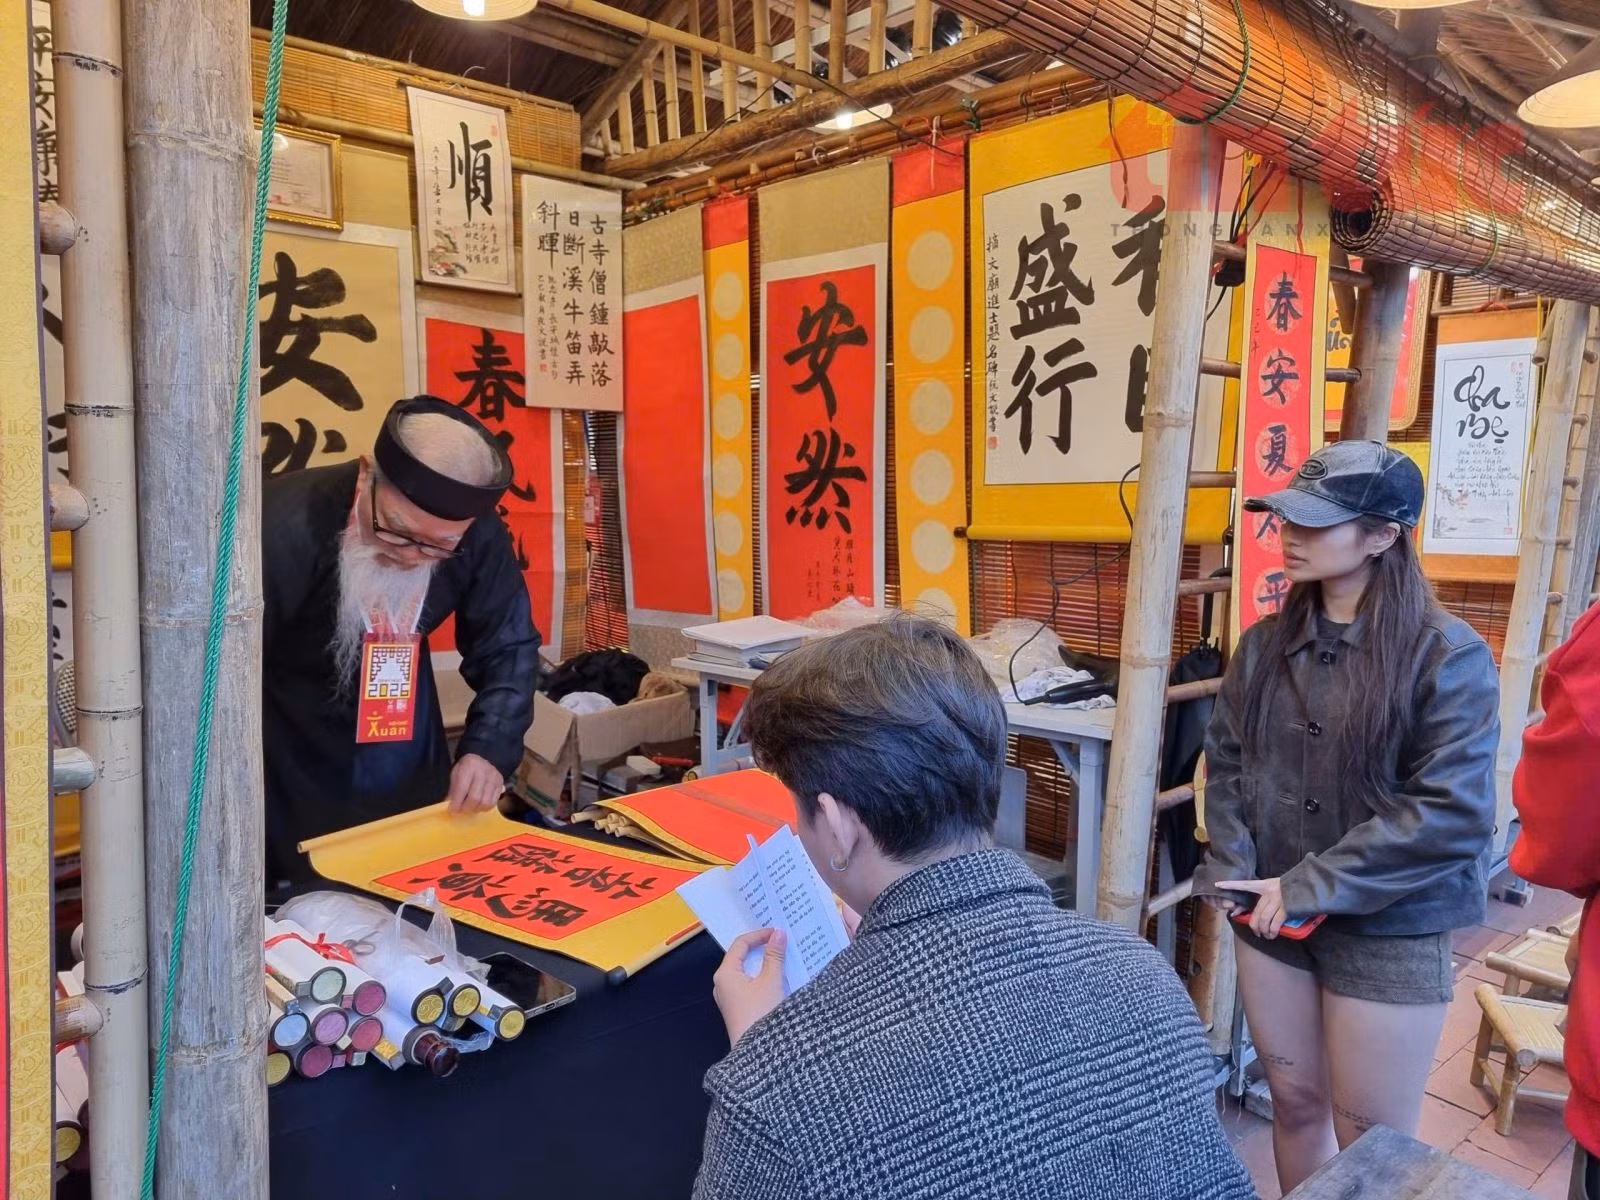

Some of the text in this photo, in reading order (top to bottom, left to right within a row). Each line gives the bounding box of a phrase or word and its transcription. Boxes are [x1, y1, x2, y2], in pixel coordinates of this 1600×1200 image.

[448, 121, 493, 222] 順
[537, 200, 560, 270] 斜暉
[562, 210, 586, 387] 日斷溪牛笛弄
[1003, 193, 1098, 456] 盛行
[783, 281, 869, 535] 安然
[1256, 272, 1303, 615] 春安夏平
[1456, 413, 1510, 444] Mẹ
[472, 842, 659, 900] 菩薩
